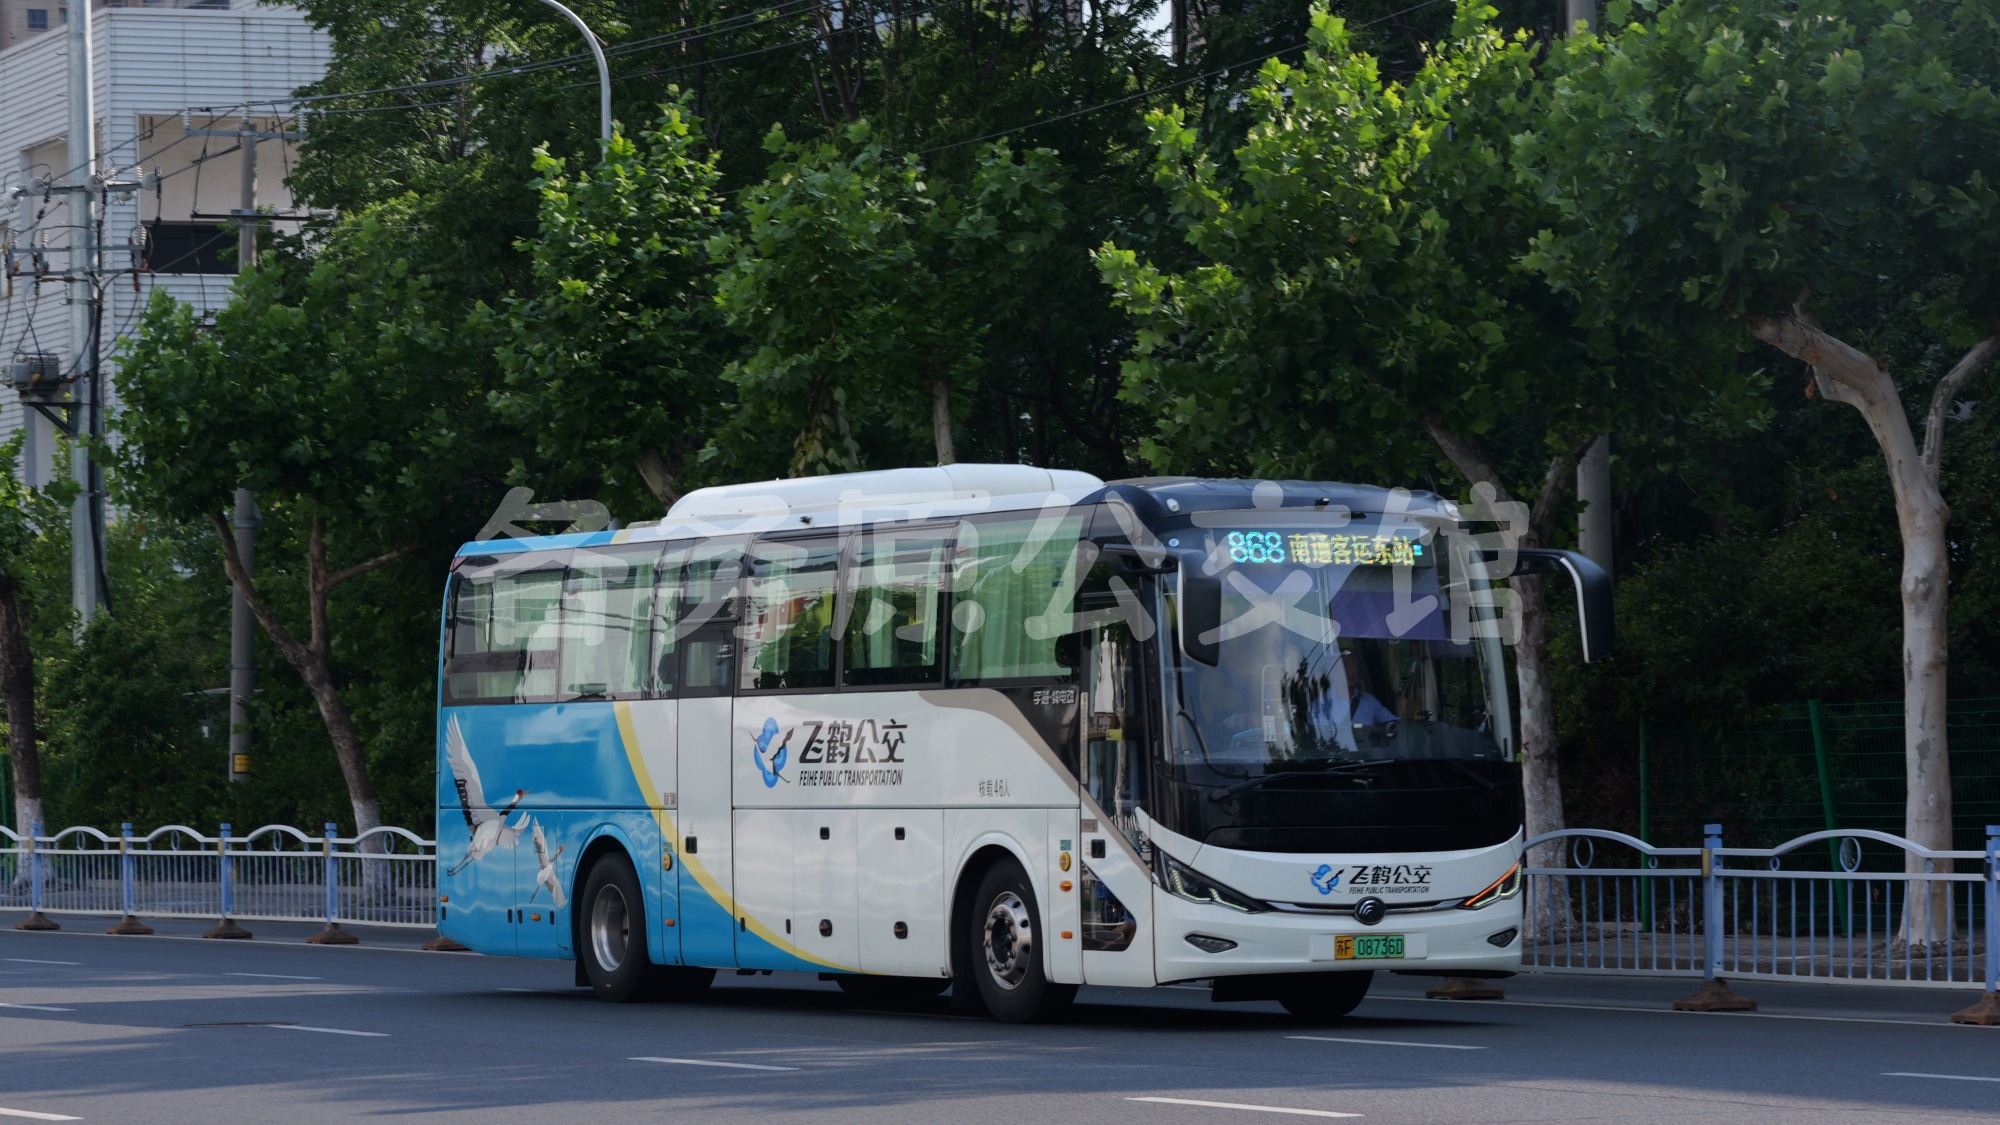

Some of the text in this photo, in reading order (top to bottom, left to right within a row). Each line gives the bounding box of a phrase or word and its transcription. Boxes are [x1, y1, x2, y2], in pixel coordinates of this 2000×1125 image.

[1227, 530, 1415, 566] 868 南通客运东站
[799, 718, 908, 764] 飞鹤公交
[799, 769, 904, 786] FEIHE PUBLIC TRANSPORTATION
[1349, 864, 1433, 885] 飞鹤公交
[1349, 885, 1430, 895] FEIHE PUBLIC TRANSPORTATION
[1336, 938, 1404, 956] 苏F 08736D
